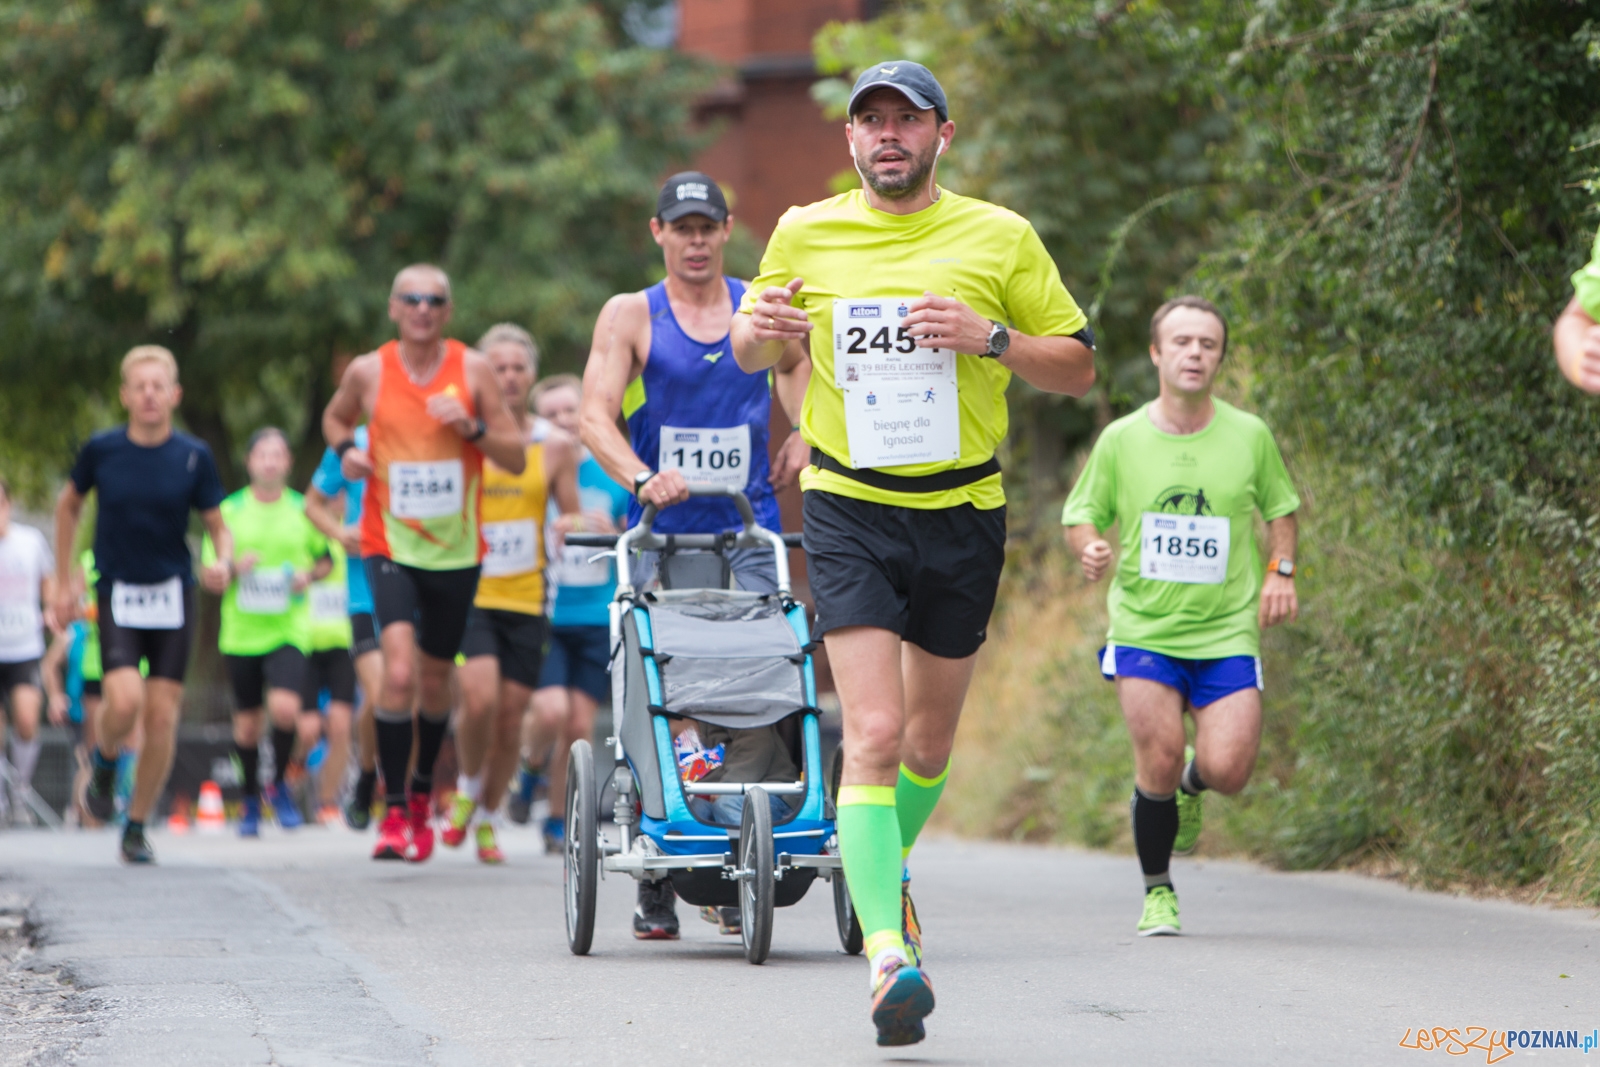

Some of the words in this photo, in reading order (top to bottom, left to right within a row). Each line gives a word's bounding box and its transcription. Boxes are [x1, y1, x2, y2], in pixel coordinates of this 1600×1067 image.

[861, 364, 872, 372] 39
[874, 363, 896, 371] BIEG
[898, 361, 944, 371] LECHITÓW
[873, 420, 910, 433] biegnę
[914, 417, 931, 428] dla
[883, 433, 923, 449] Ignasia
[672, 447, 742, 470] 1106
[1152, 535, 1218, 558] 1856
